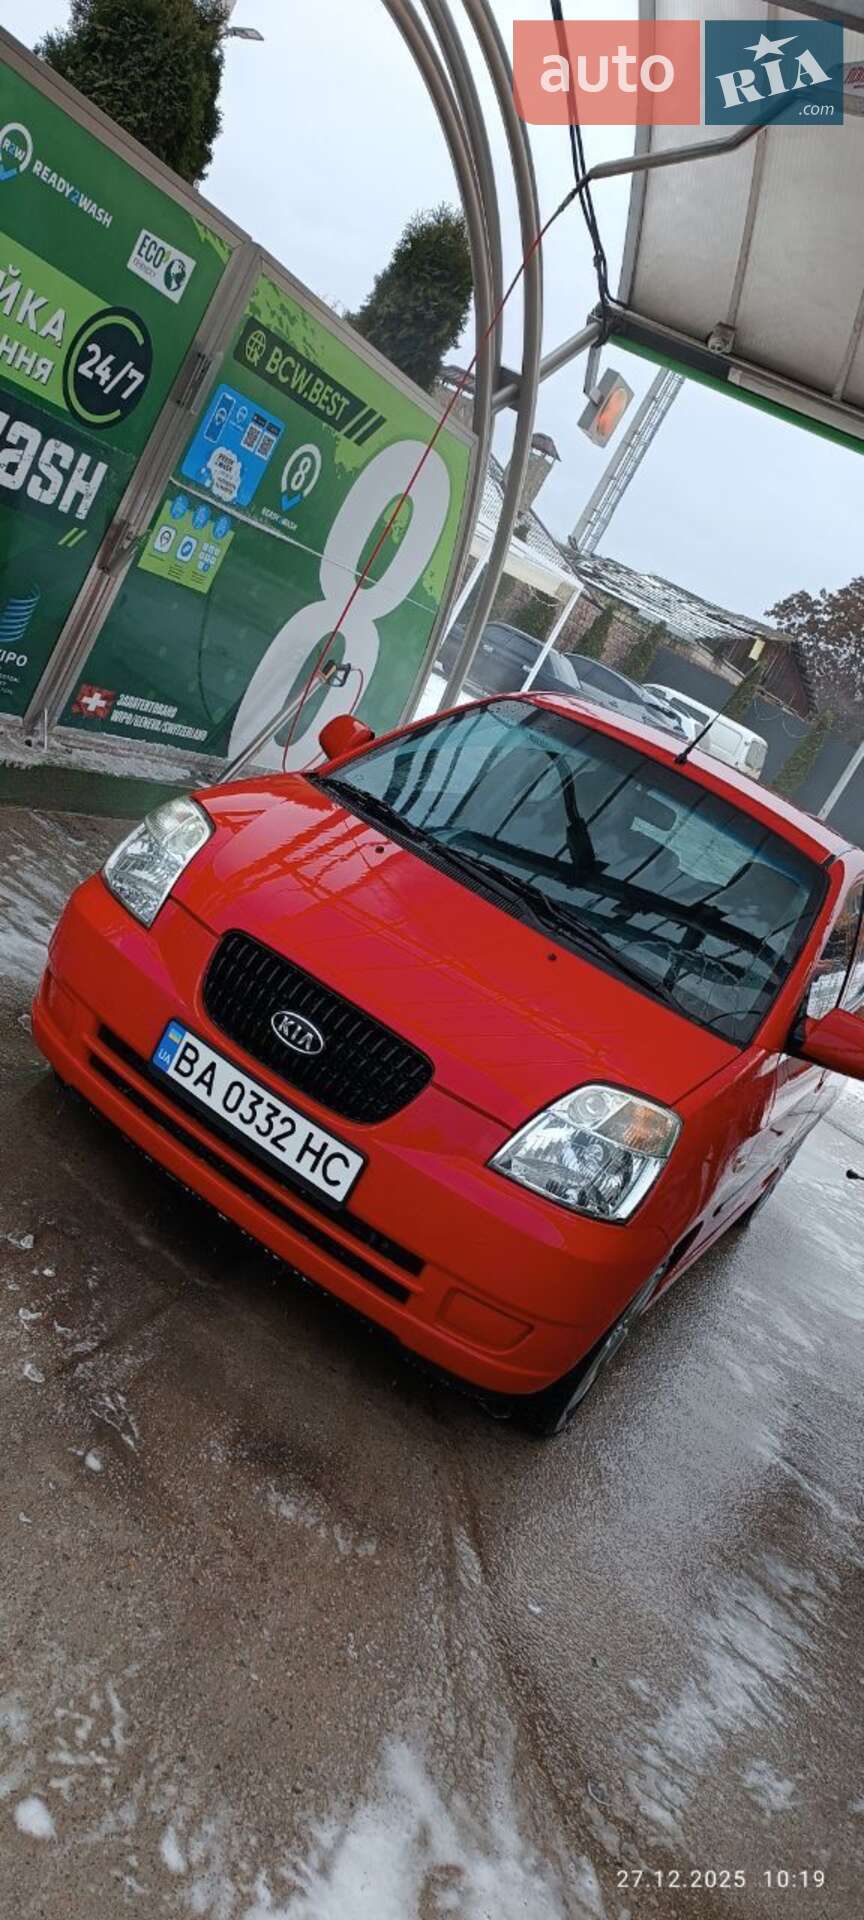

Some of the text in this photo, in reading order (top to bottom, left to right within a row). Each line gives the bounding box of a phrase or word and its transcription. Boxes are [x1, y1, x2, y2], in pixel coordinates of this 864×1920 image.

[32, 159, 114, 229] READY2WASH
[137, 234, 166, 269] ECO
[77, 342, 145, 400] 24/7
[265, 346, 350, 421] BCW.BEST
[291, 456, 312, 491] 8
[277, 1014, 316, 1051] KIA
[158, 1048, 170, 1066] UA
[173, 1041, 350, 1187] BA 0332 HC
